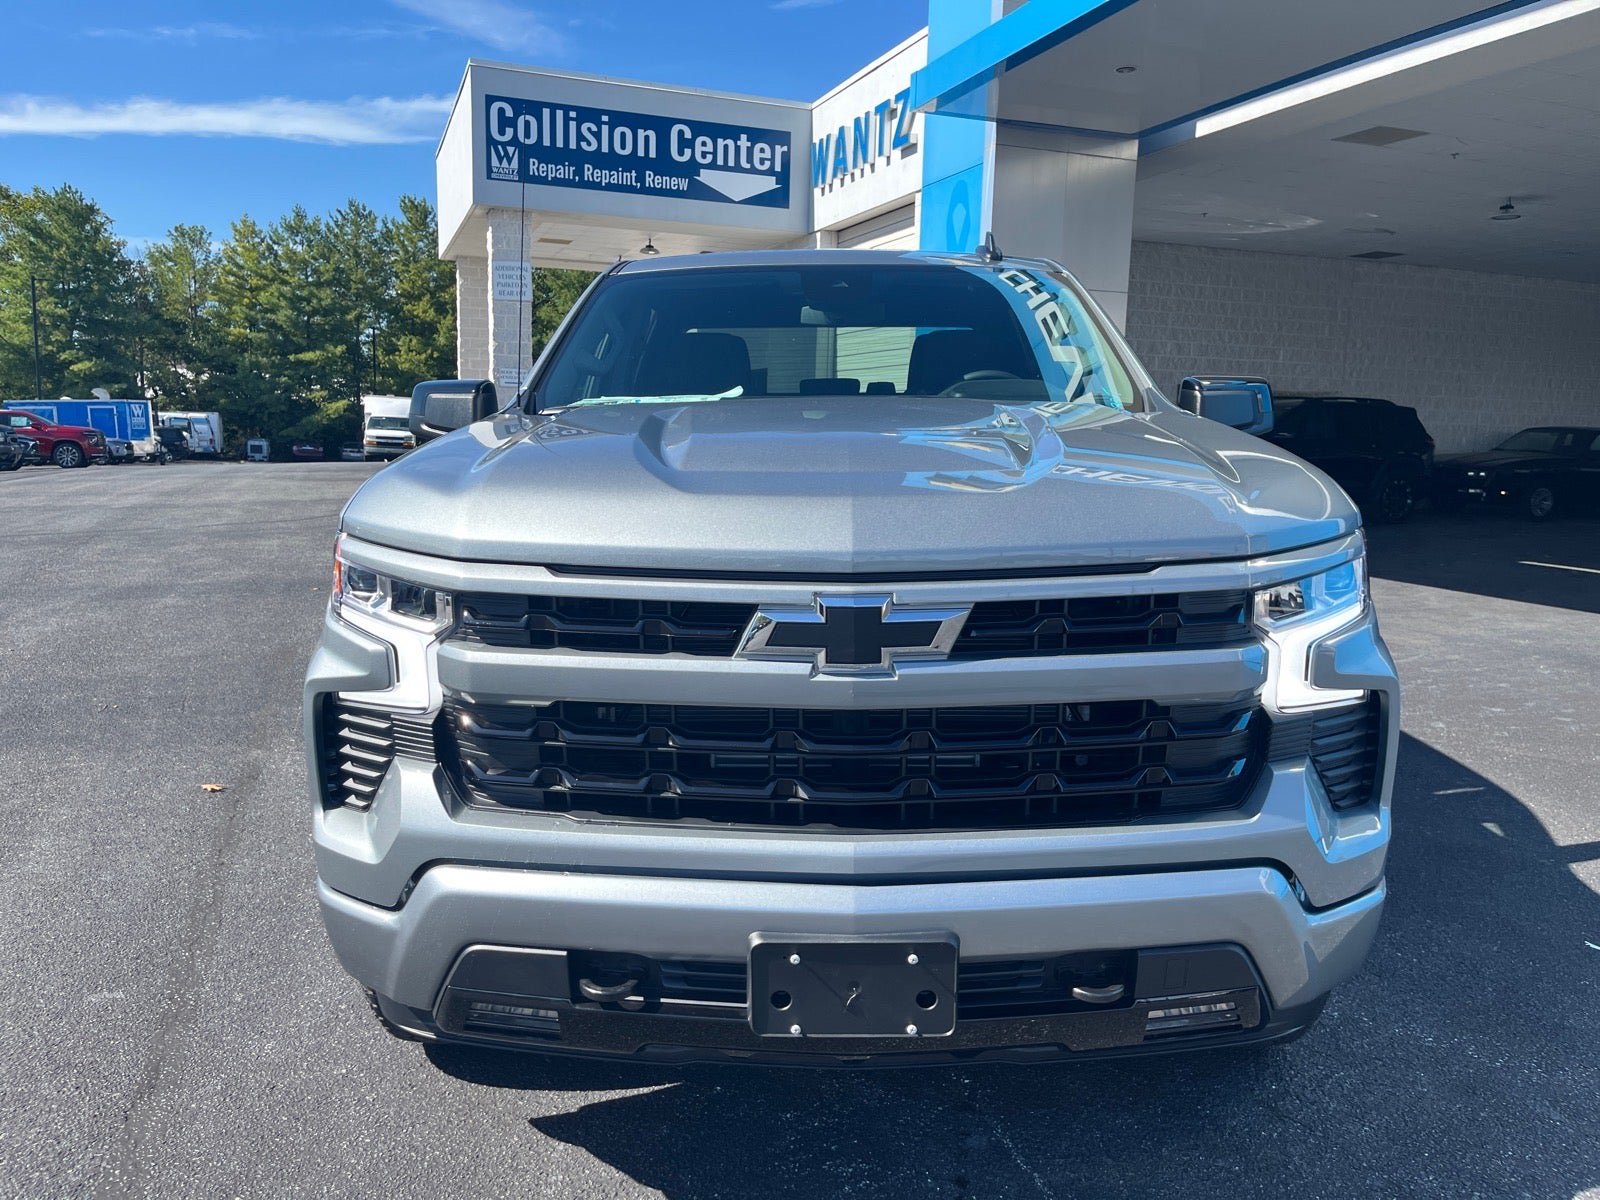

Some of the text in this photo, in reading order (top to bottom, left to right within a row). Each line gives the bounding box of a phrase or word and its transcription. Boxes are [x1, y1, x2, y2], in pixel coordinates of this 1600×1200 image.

[489, 101, 789, 172] Collision Center
[812, 87, 911, 189] WANTZ
[492, 167, 518, 175] WANTZ
[529, 158, 689, 191] Repair, Repaint, Renew
